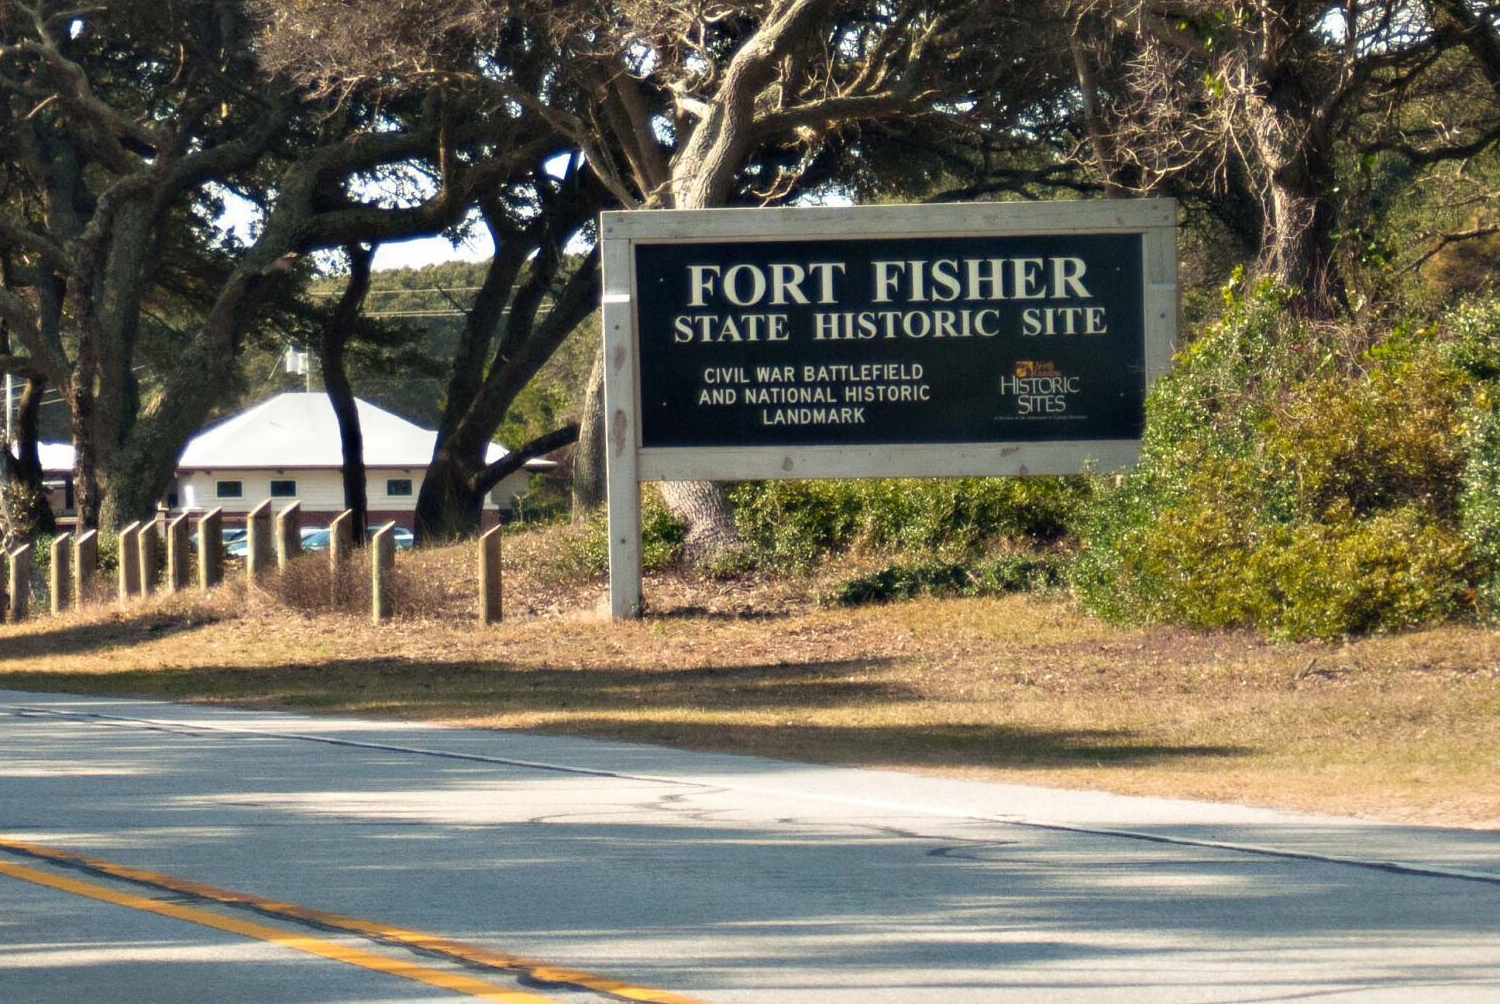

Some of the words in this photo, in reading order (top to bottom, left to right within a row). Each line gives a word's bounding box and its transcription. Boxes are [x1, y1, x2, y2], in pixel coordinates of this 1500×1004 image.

[686, 262, 846, 307] FORT
[871, 257, 1094, 303] FISHER
[674, 313, 790, 343] STATE
[813, 309, 1000, 340] HISTORIC
[1022, 306, 1108, 336] SITE
[703, 367, 750, 384] CIVIL
[756, 366, 796, 383] WAR
[803, 364, 924, 382] BATTLEFIELD
[698, 388, 737, 405] AND
[745, 386, 837, 404] NATIONAL
[845, 385, 931, 403] HISTORIC
[1000, 375, 1080, 395] HISTORIC
[1017, 395, 1067, 415] SITES
[763, 407, 866, 425] LANDMARK
